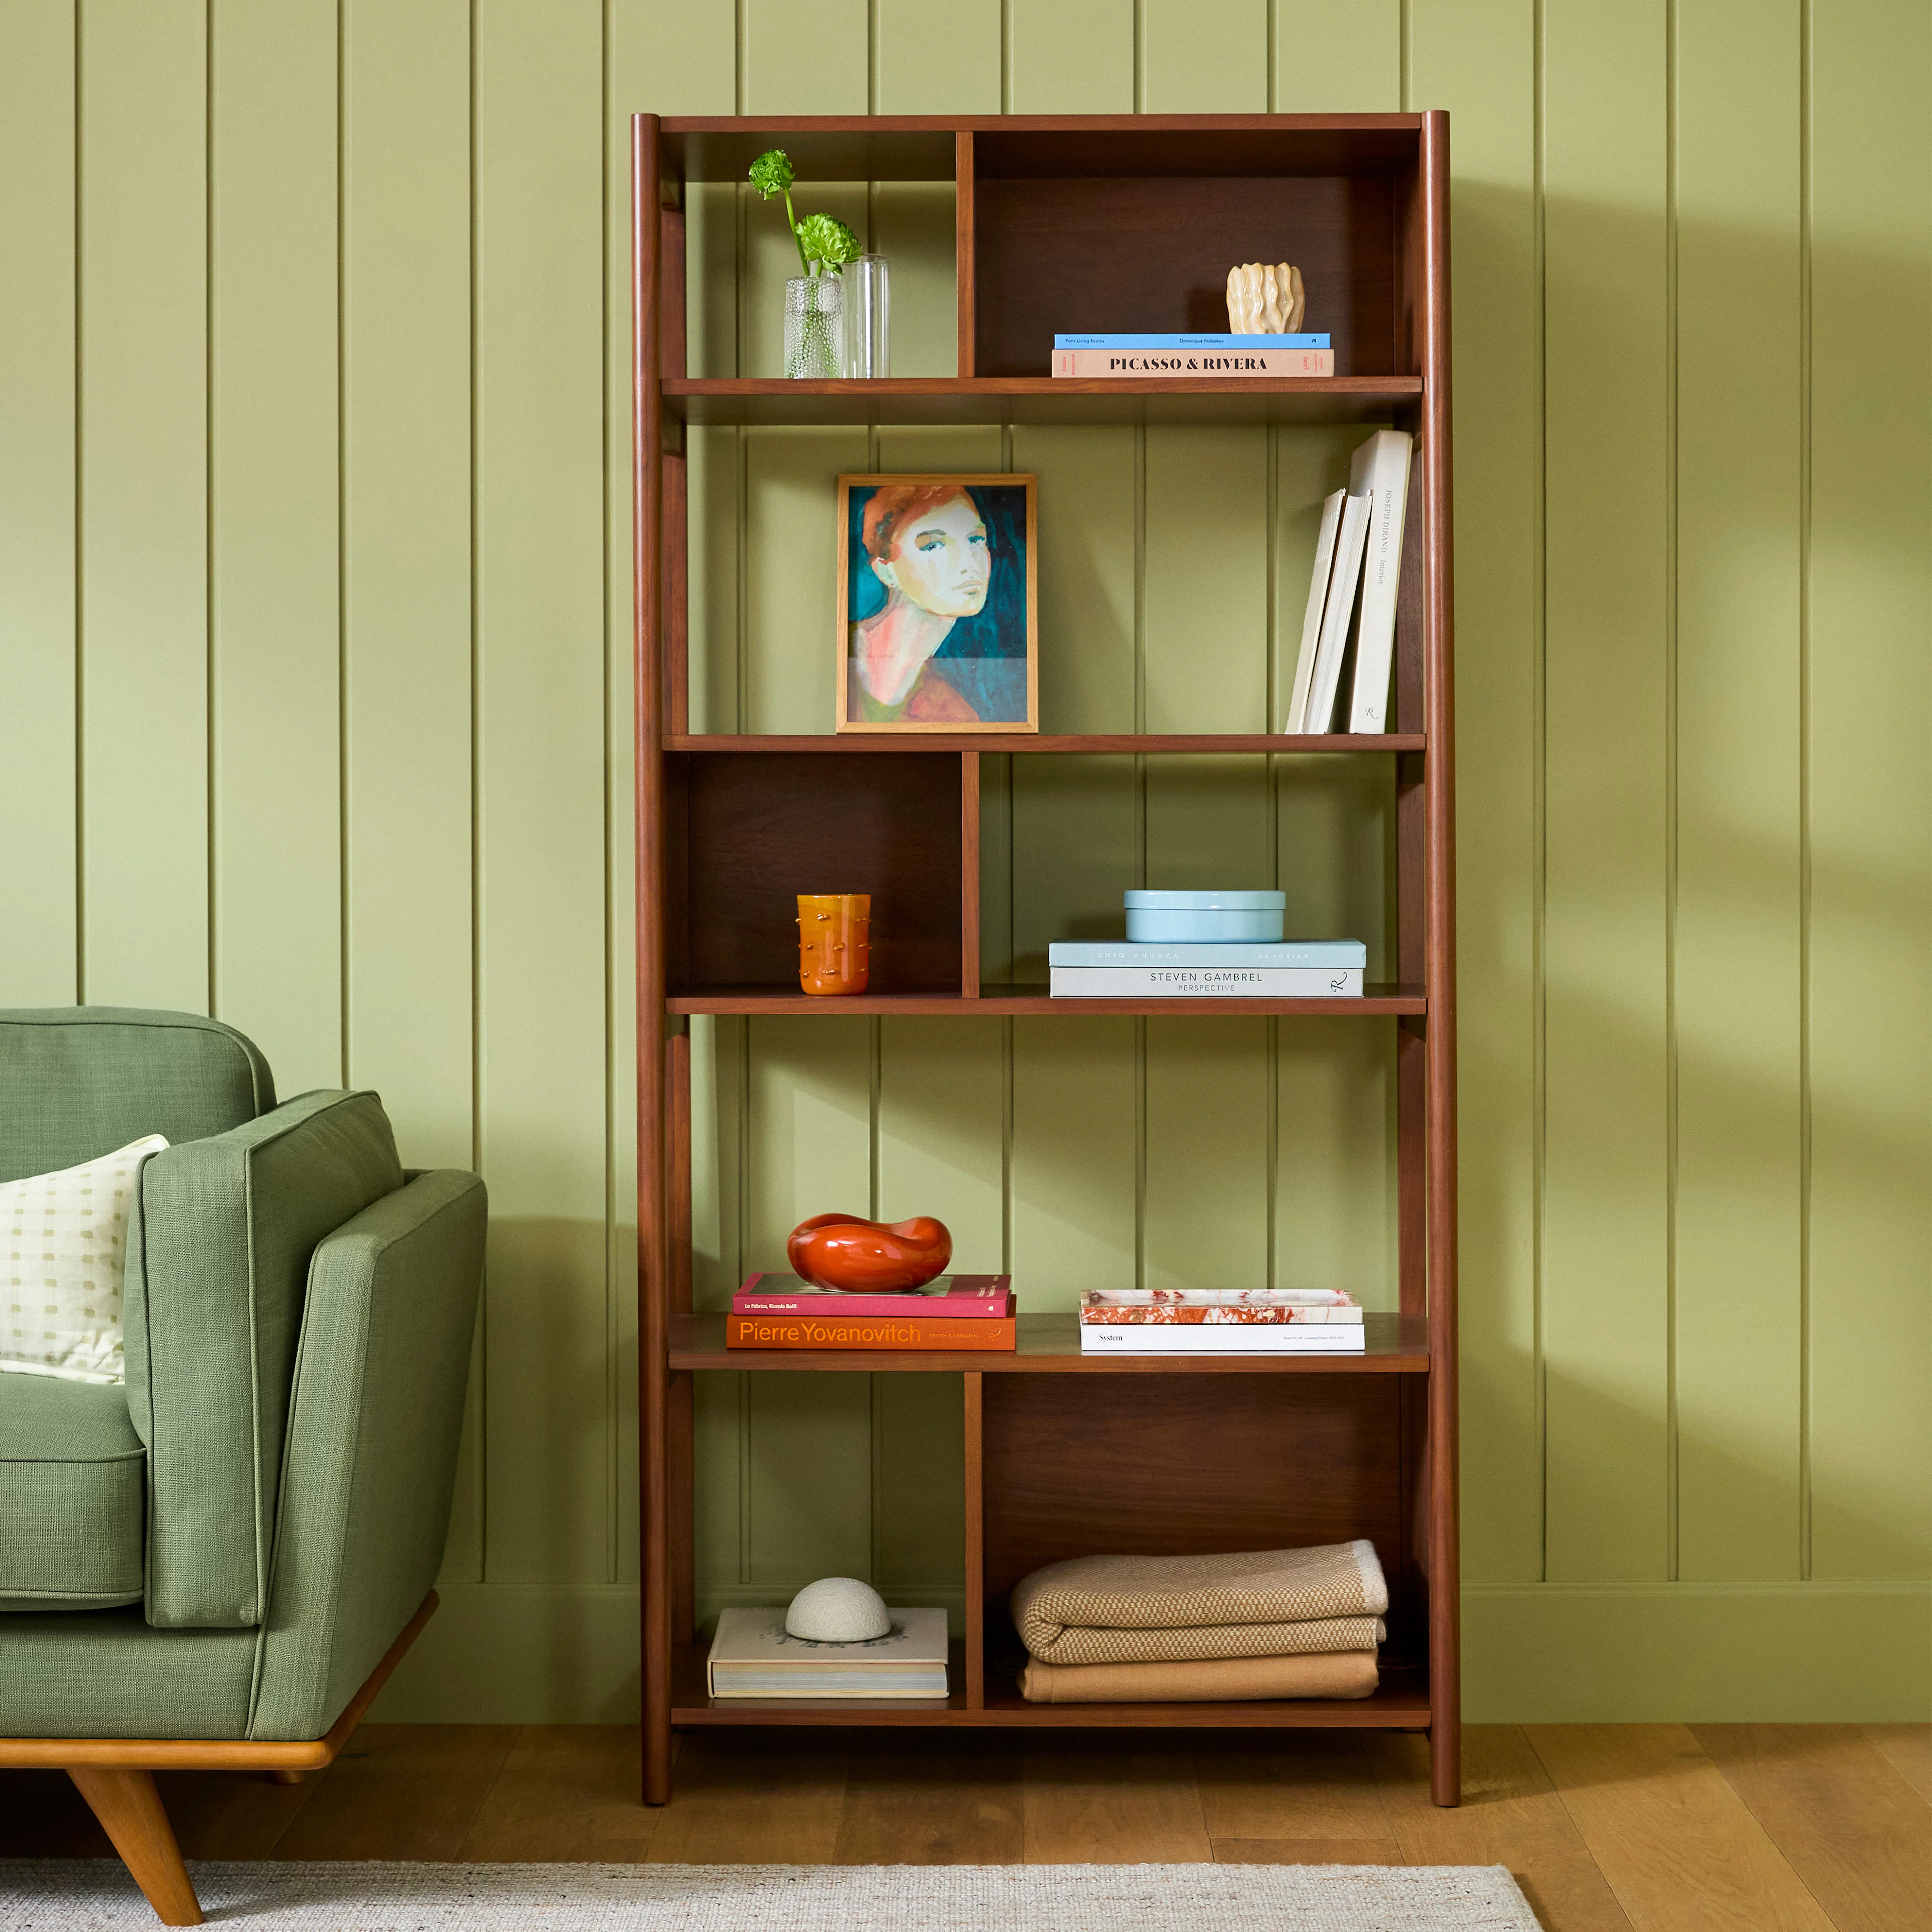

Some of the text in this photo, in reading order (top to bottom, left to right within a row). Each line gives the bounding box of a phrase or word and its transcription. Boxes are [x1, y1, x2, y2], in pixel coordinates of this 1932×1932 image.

[1110, 358, 1267, 370] PICASSO & RIVERA
[1378, 489, 1392, 585] JOSEPH DIRAND Interior
[1365, 707, 1378, 719] R
[1150, 973, 1263, 981] STEVEN GAMBREL
[739, 1322, 921, 1342] Pierre Yovanovitch
[1098, 1334, 1123, 1343] System
